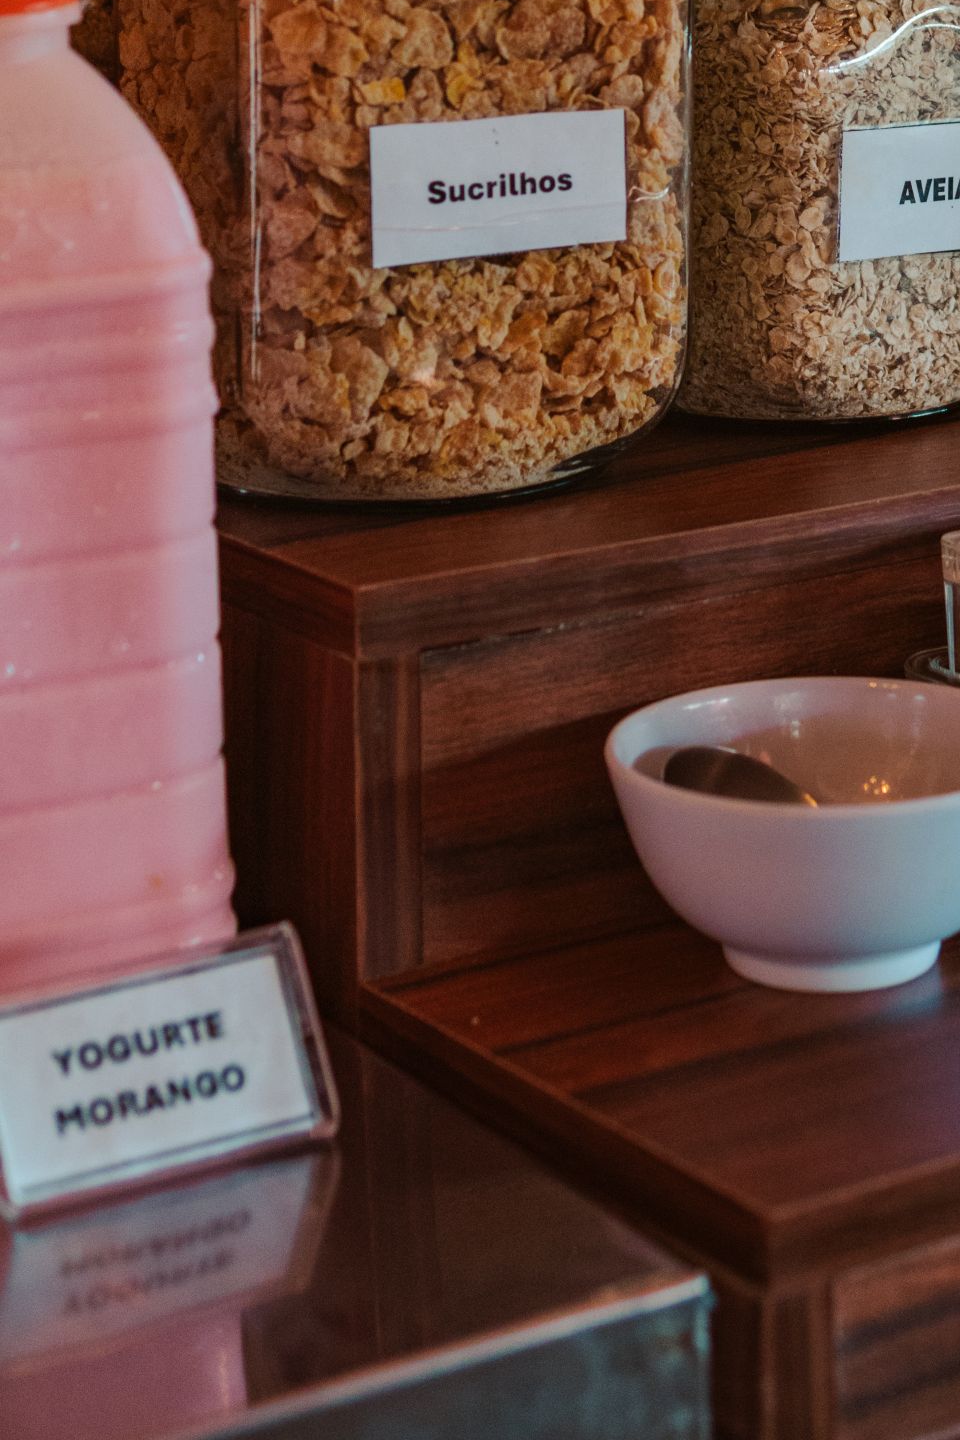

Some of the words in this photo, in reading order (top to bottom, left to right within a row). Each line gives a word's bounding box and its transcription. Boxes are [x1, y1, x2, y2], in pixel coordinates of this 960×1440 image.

[428, 172, 573, 204] Sucrilhos
[52, 1010, 224, 1076] YOGURTE
[55, 1063, 246, 1135] MORANGO
